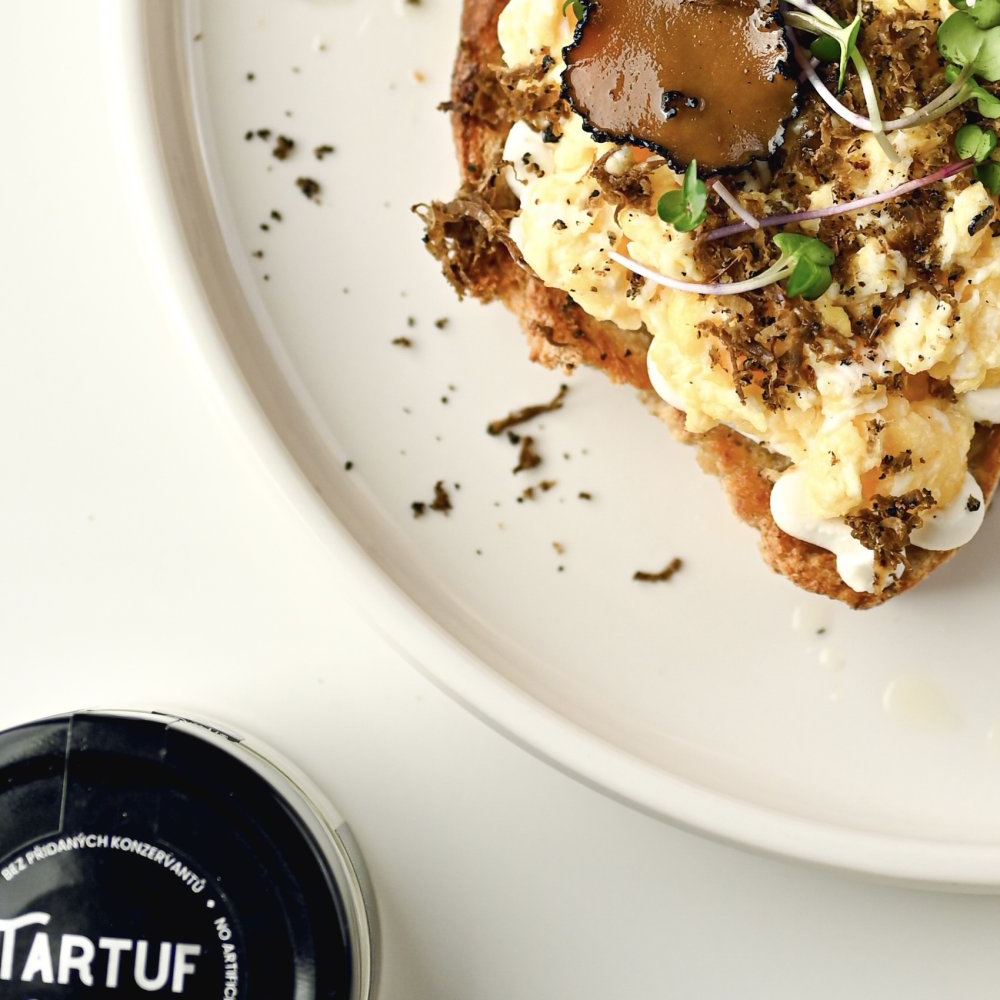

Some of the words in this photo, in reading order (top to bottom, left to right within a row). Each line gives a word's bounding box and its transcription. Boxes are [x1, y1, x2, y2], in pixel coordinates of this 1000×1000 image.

[1, 856, 28, 881] BEZ
[25, 832, 109, 865] PŘIDANÝCH
[213, 916, 232, 941] NO
[0, 911, 201, 993] TARTUF
